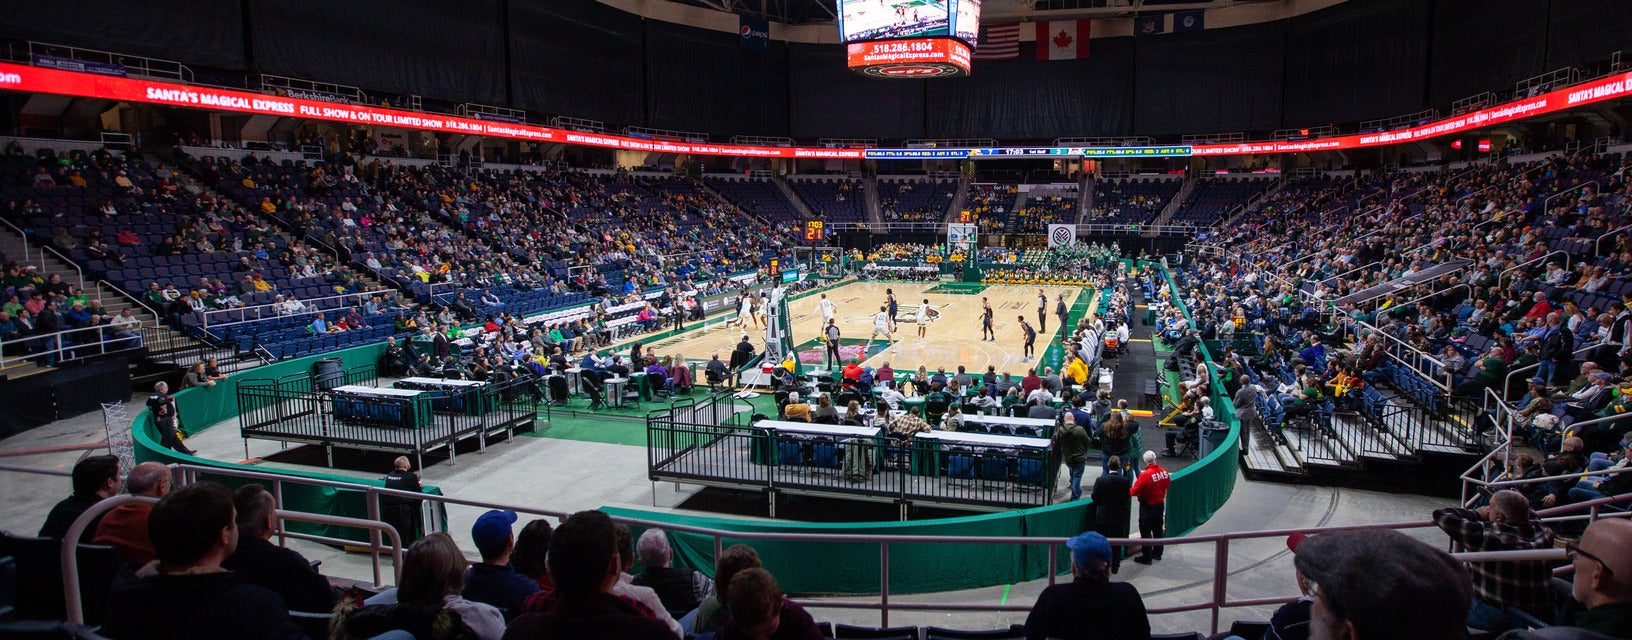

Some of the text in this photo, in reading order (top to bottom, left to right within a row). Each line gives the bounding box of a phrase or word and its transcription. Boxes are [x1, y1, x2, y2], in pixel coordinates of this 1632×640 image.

[874, 42, 932, 53] 518.286.1804
[864, 52, 944, 61] SantasMagicalExpress.com
[1568, 91, 1594, 104] SANTA'S
[1594, 81, 1624, 98] MAGICAL
[146, 86, 294, 113] SANTA'S MAGICAL EXPRESS
[300, 105, 442, 128] FULL SHOW & ON TOUR LIMITED SHOW
[446, 121, 482, 132] 518.286.1804
[487, 125, 552, 138] SantasMagicalExpress.com
[566, 134, 584, 143] SANTA'S
[1360, 136, 1378, 144] SANTA'S
[808, 228, 820, 239] 21
[1152, 470, 1169, 482] EMS
